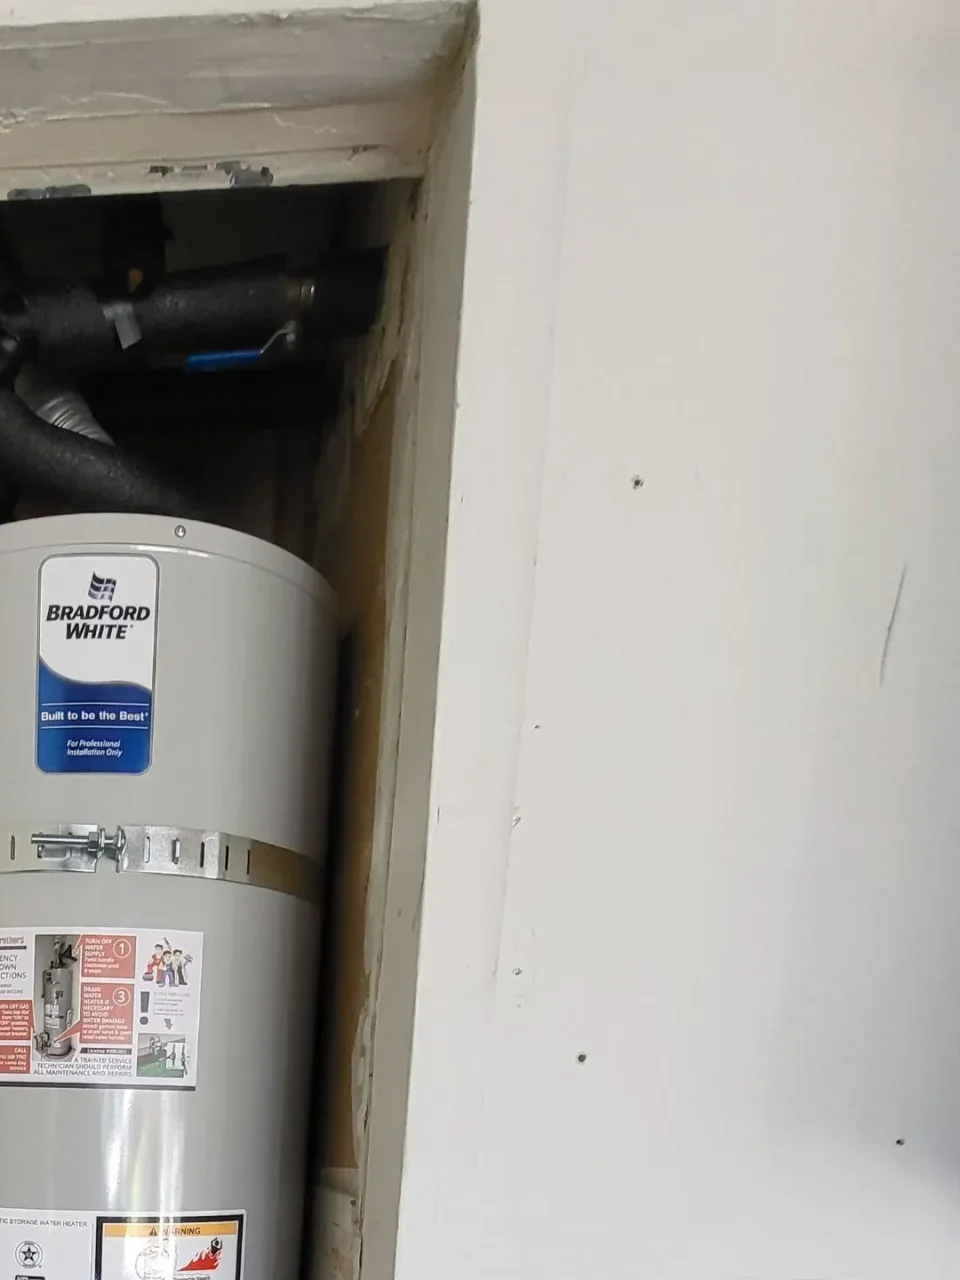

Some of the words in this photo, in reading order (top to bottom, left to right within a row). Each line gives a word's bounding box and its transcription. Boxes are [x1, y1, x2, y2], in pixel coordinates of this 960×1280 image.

[46, 605, 150, 621] BRADFORD
[66, 623, 127, 639] WHITE
[41, 711, 64, 721] Built
[67, 711, 78, 721] to
[81, 711, 95, 721] be
[99, 711, 116, 721] the
[67, 740, 78, 748] For
[80, 739, 121, 748] Professional
[106, 749, 123, 758] Only
[119, 943, 124, 955] 1
[118, 991, 125, 1003] 3
[9, 1218, 38, 1226] STORAGE
[161, 1227, 201, 1236] WRNING
